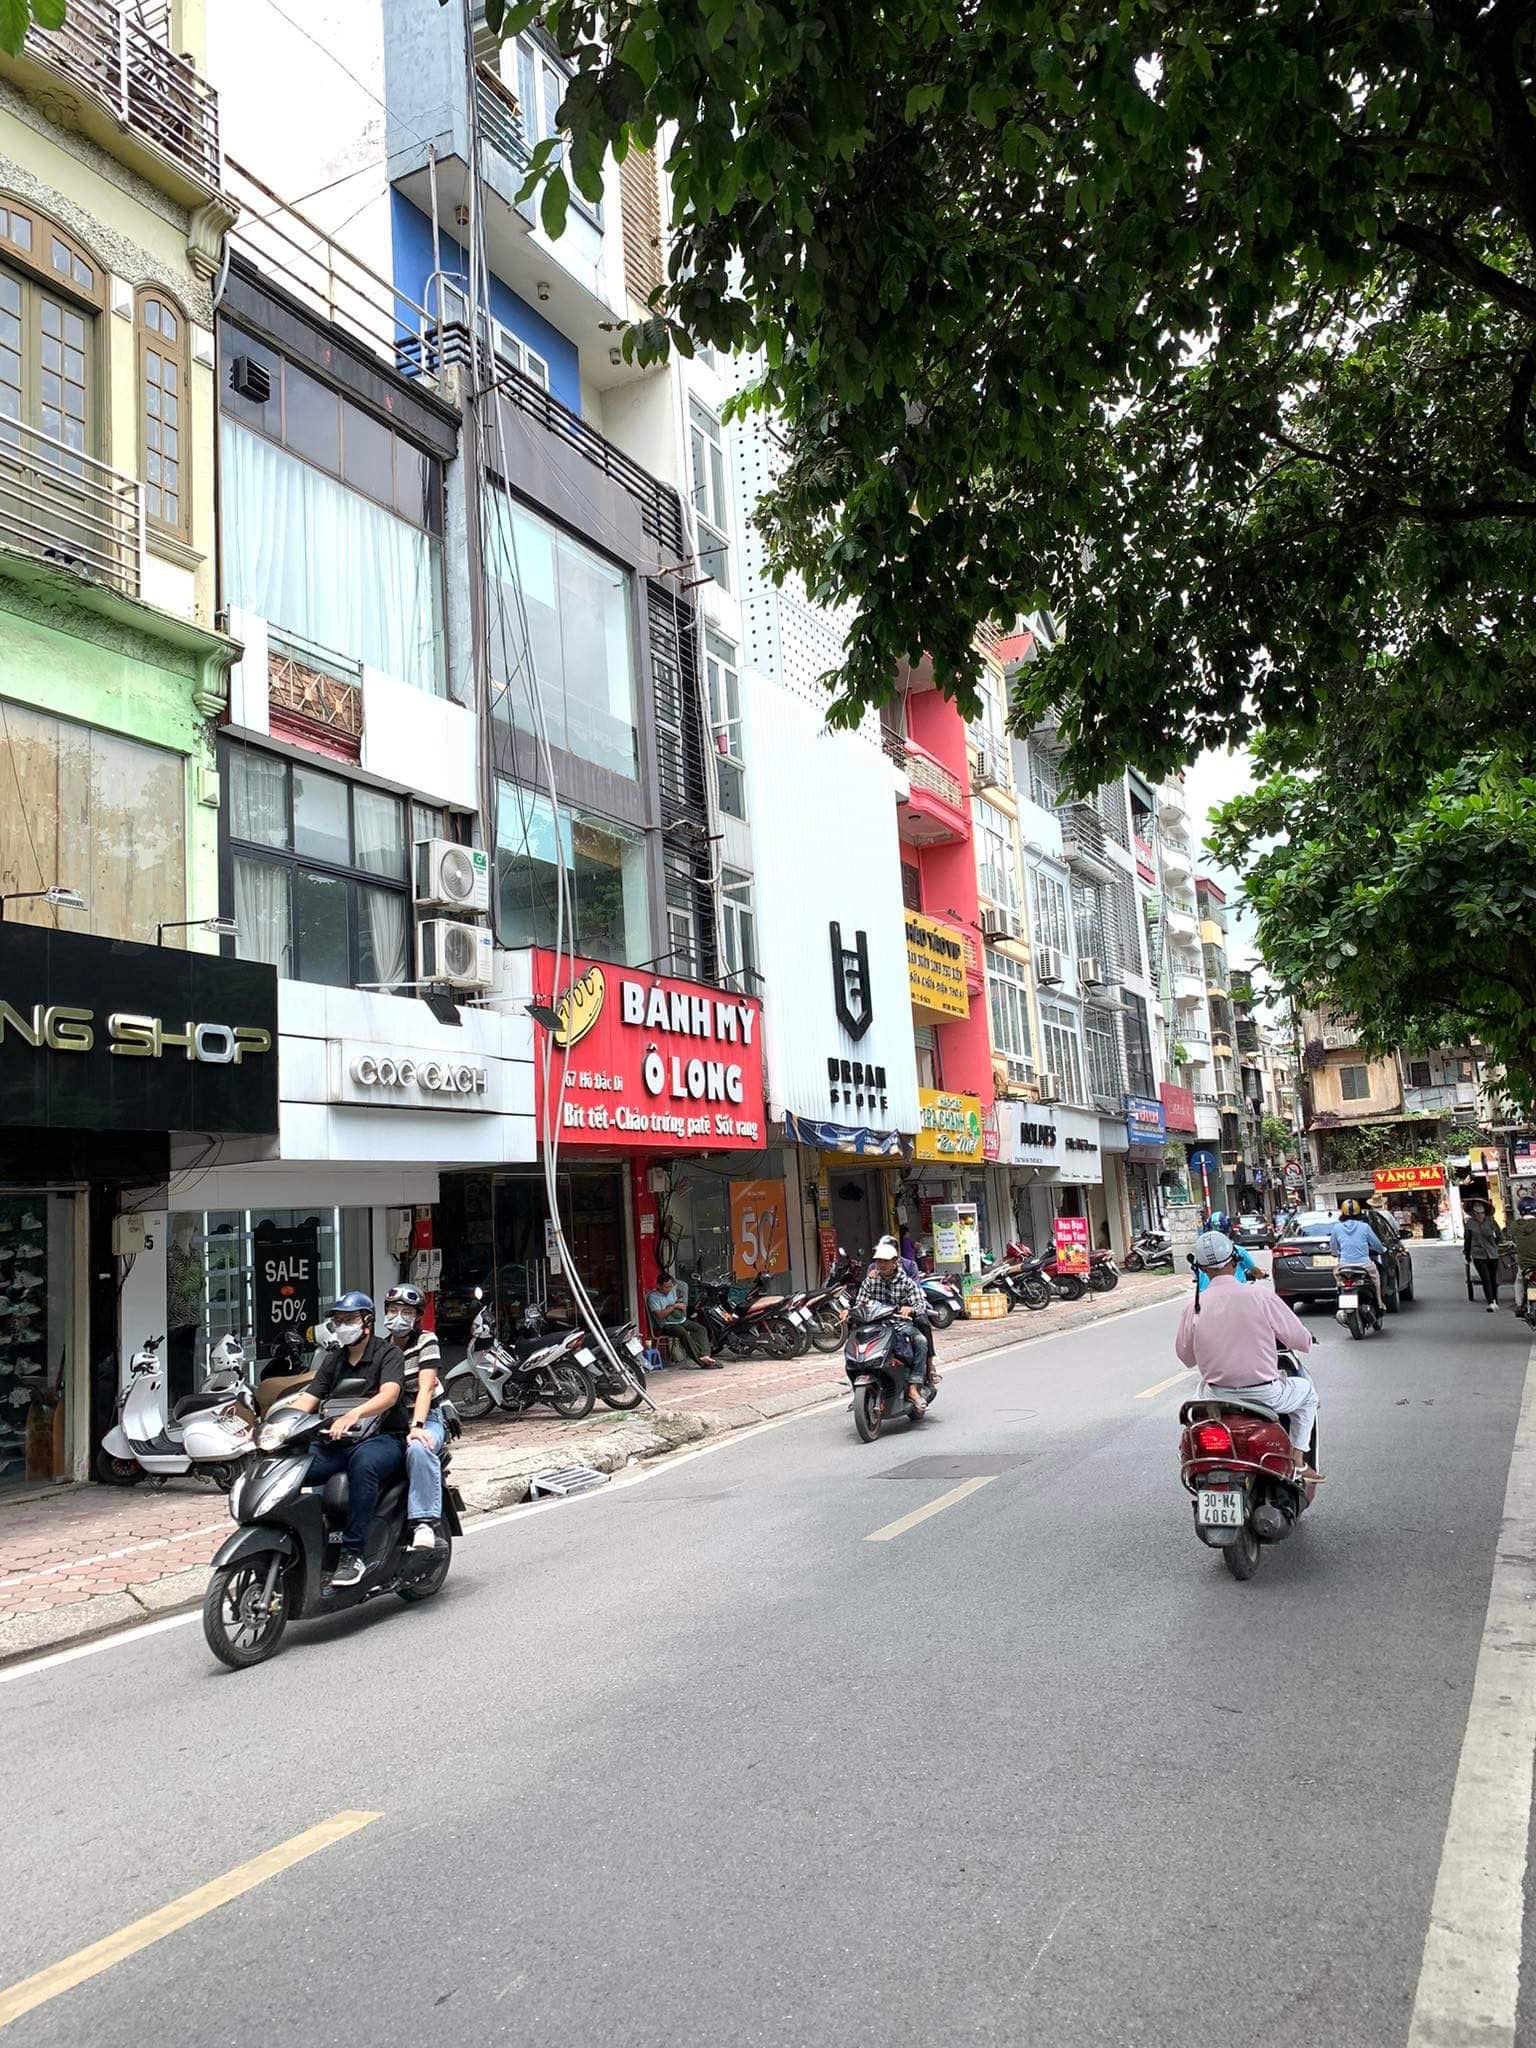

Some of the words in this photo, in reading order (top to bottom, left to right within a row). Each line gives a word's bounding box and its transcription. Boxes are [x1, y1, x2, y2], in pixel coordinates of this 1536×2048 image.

[621, 979, 711, 1038] BÁNH
[714, 998, 755, 1045] MỲ
[108, 1013, 272, 1065] SHOP
[643, 1043, 665, 1096] Ô
[670, 1056, 744, 1104] LONG
[827, 1057, 887, 1089] URBAN
[829, 1089, 889, 1110] STORE
[1375, 1169, 1416, 1183] VÀNG
[265, 1255, 309, 1283] SALE
[271, 1298, 307, 1324] 50%
[1204, 1509, 1236, 1524] 4064
